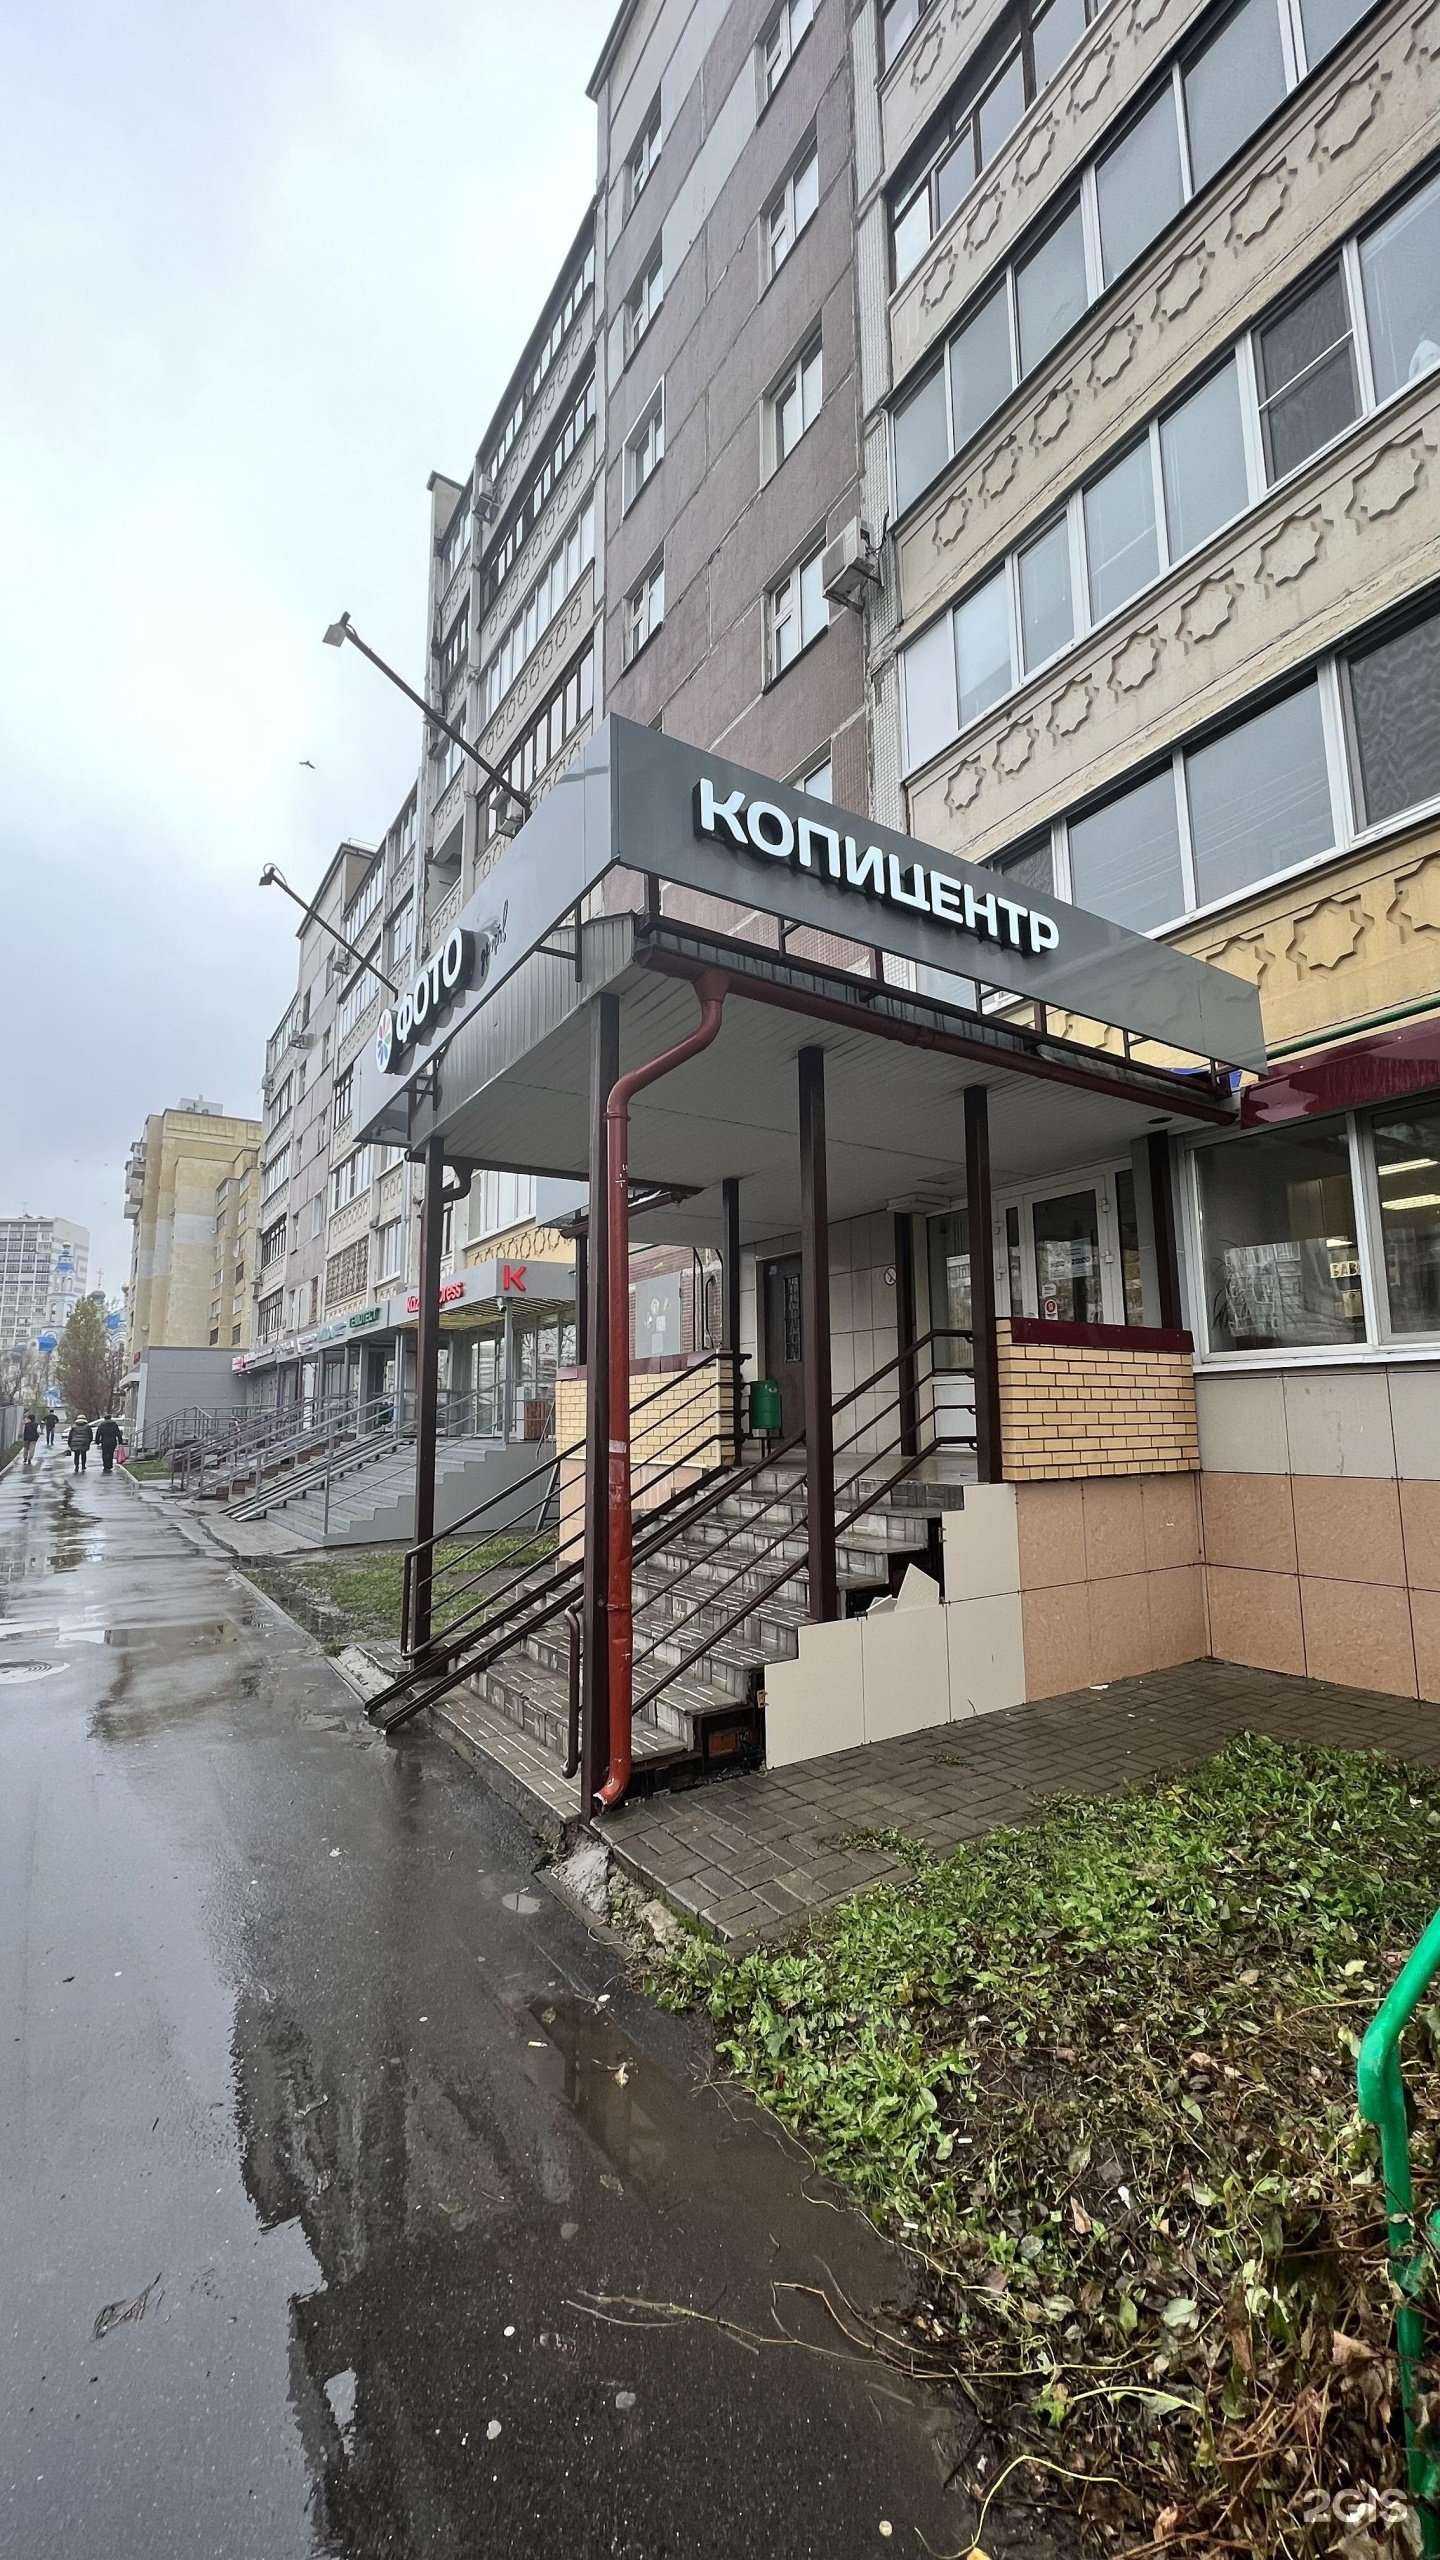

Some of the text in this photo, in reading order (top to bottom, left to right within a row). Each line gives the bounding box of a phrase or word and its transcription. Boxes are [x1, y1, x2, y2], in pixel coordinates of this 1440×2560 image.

[697, 777, 1061, 955] КОПИЦЕНТР
[396, 927, 464, 1044] ФОТО
[503, 1264, 527, 1292] K
